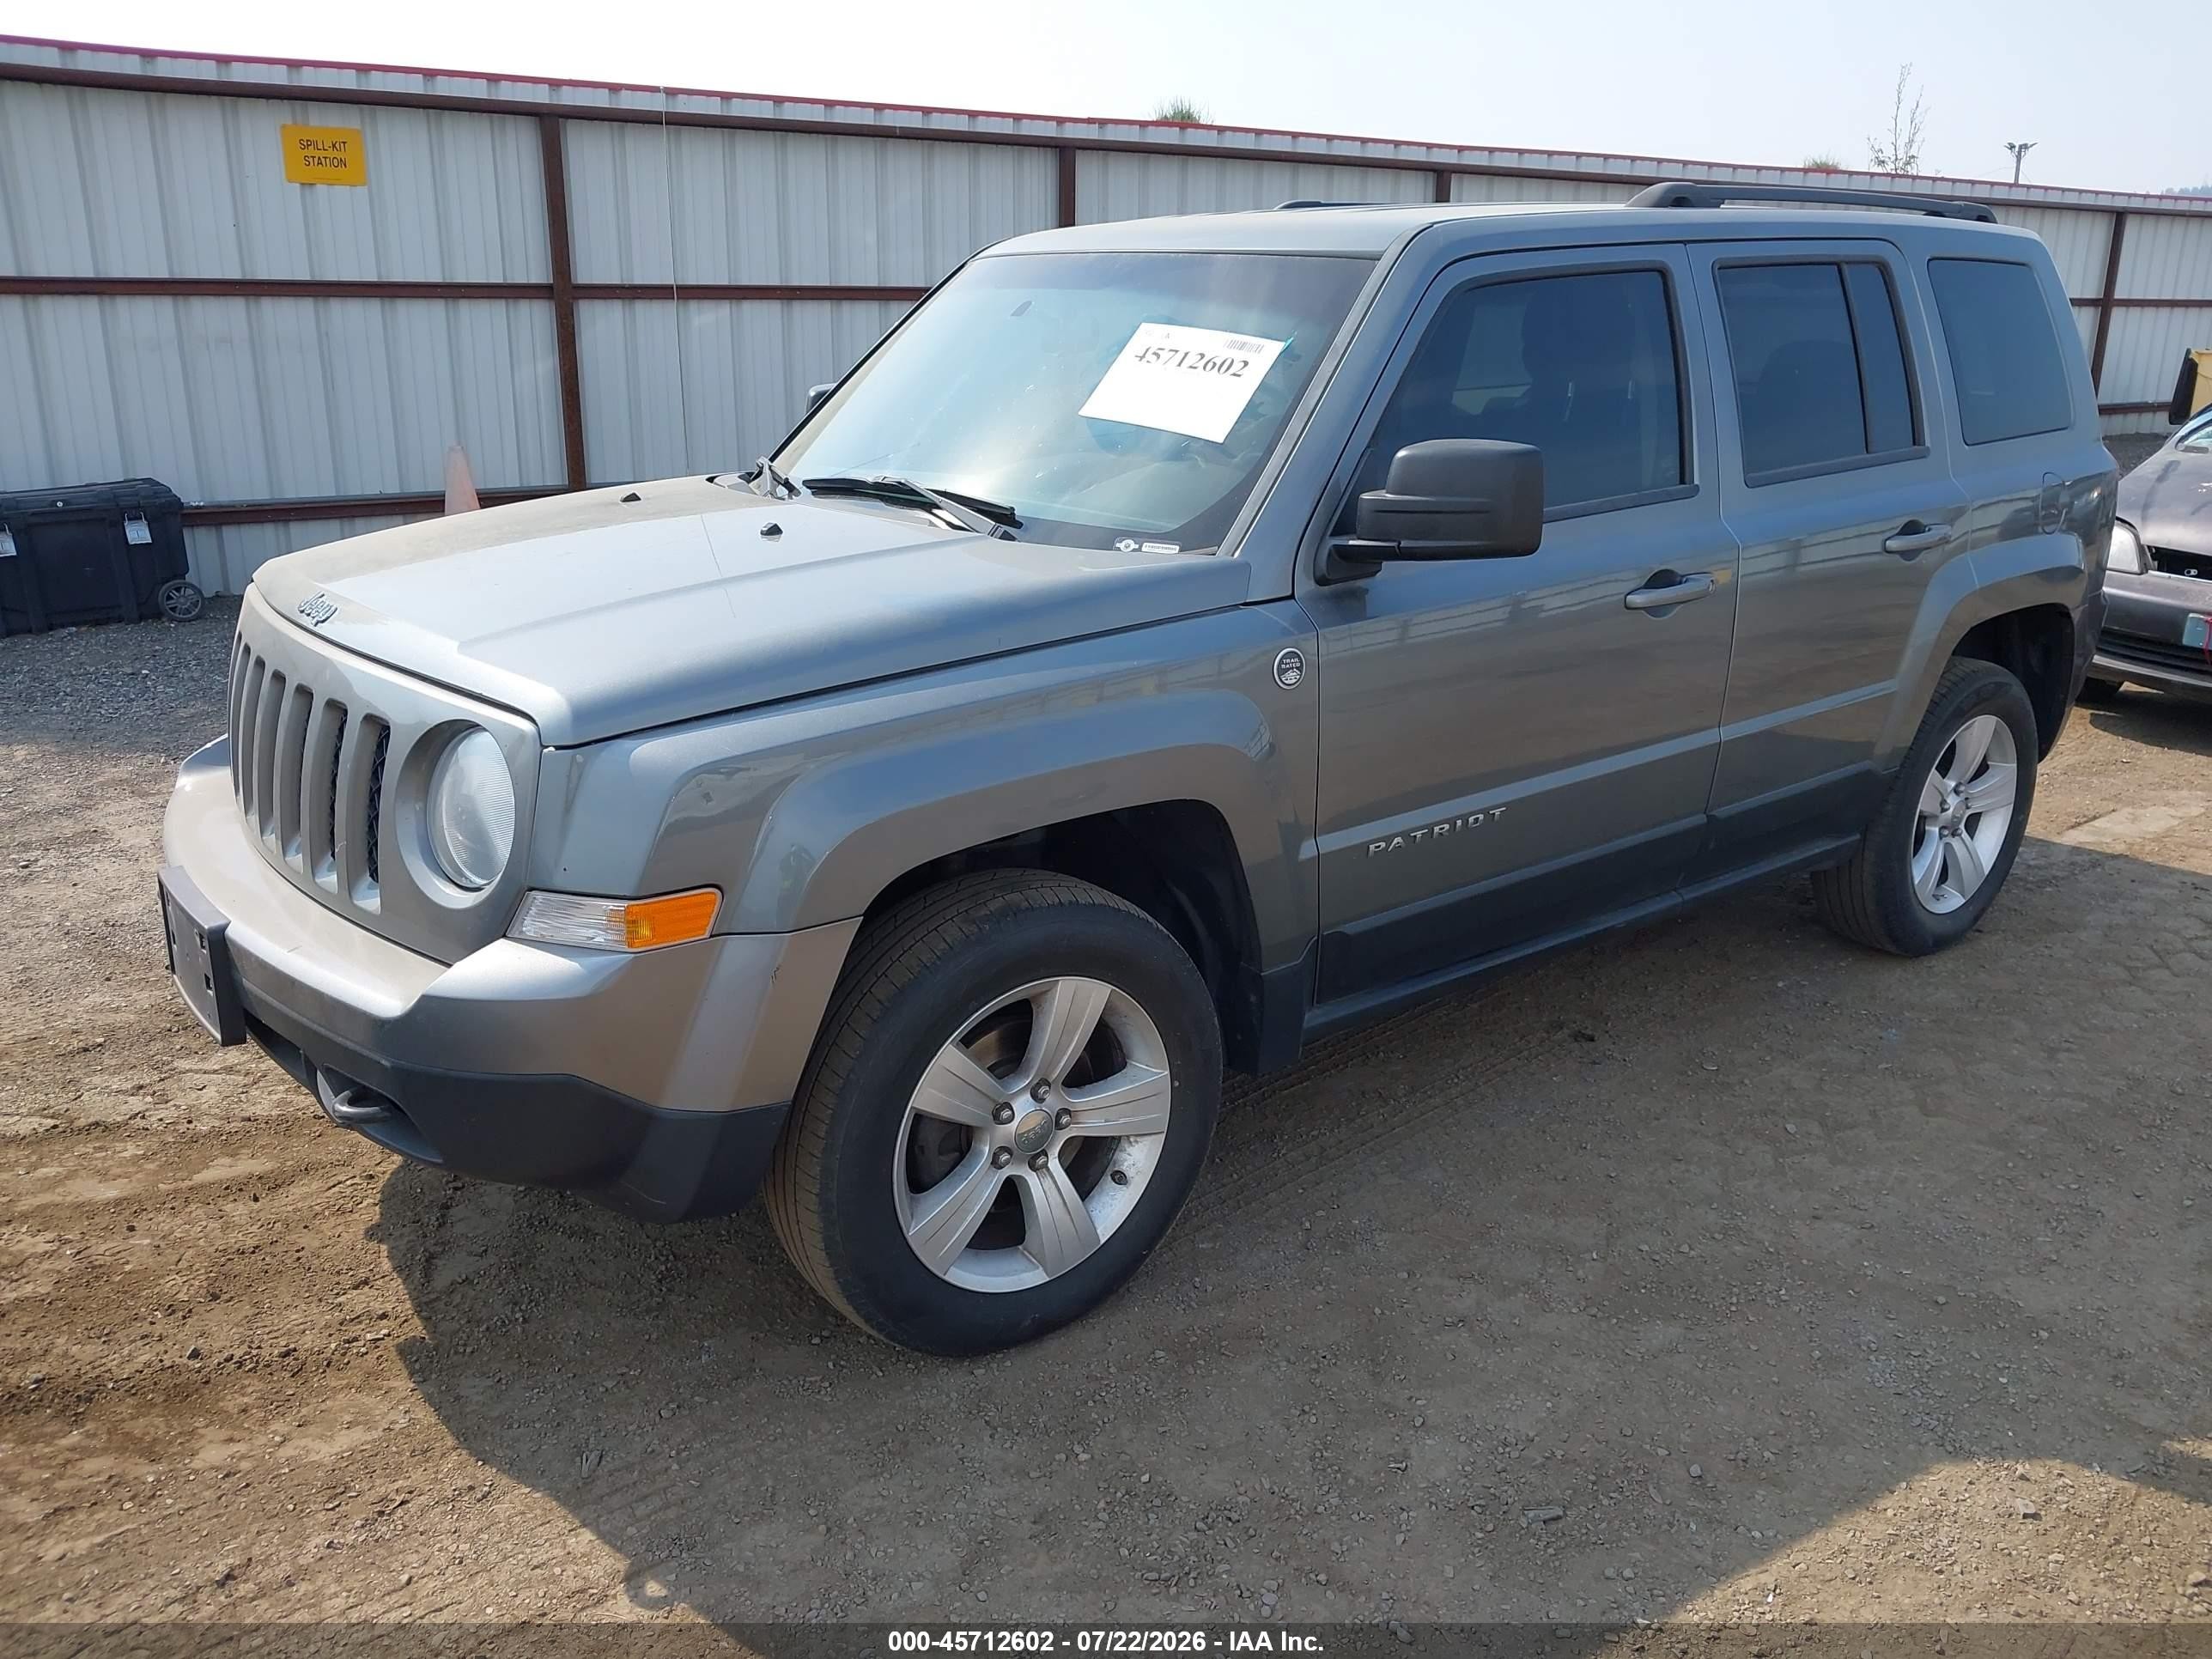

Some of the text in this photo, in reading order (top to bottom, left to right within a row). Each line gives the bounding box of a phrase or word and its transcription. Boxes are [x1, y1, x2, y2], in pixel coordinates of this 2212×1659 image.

[299, 138, 348, 152] SPILL-KIT
[303, 155, 348, 168] STATION
[1134, 345, 1250, 378] 45712602
[297, 590, 338, 628] Jeep
[1366, 807, 1507, 859] PATRIOT
